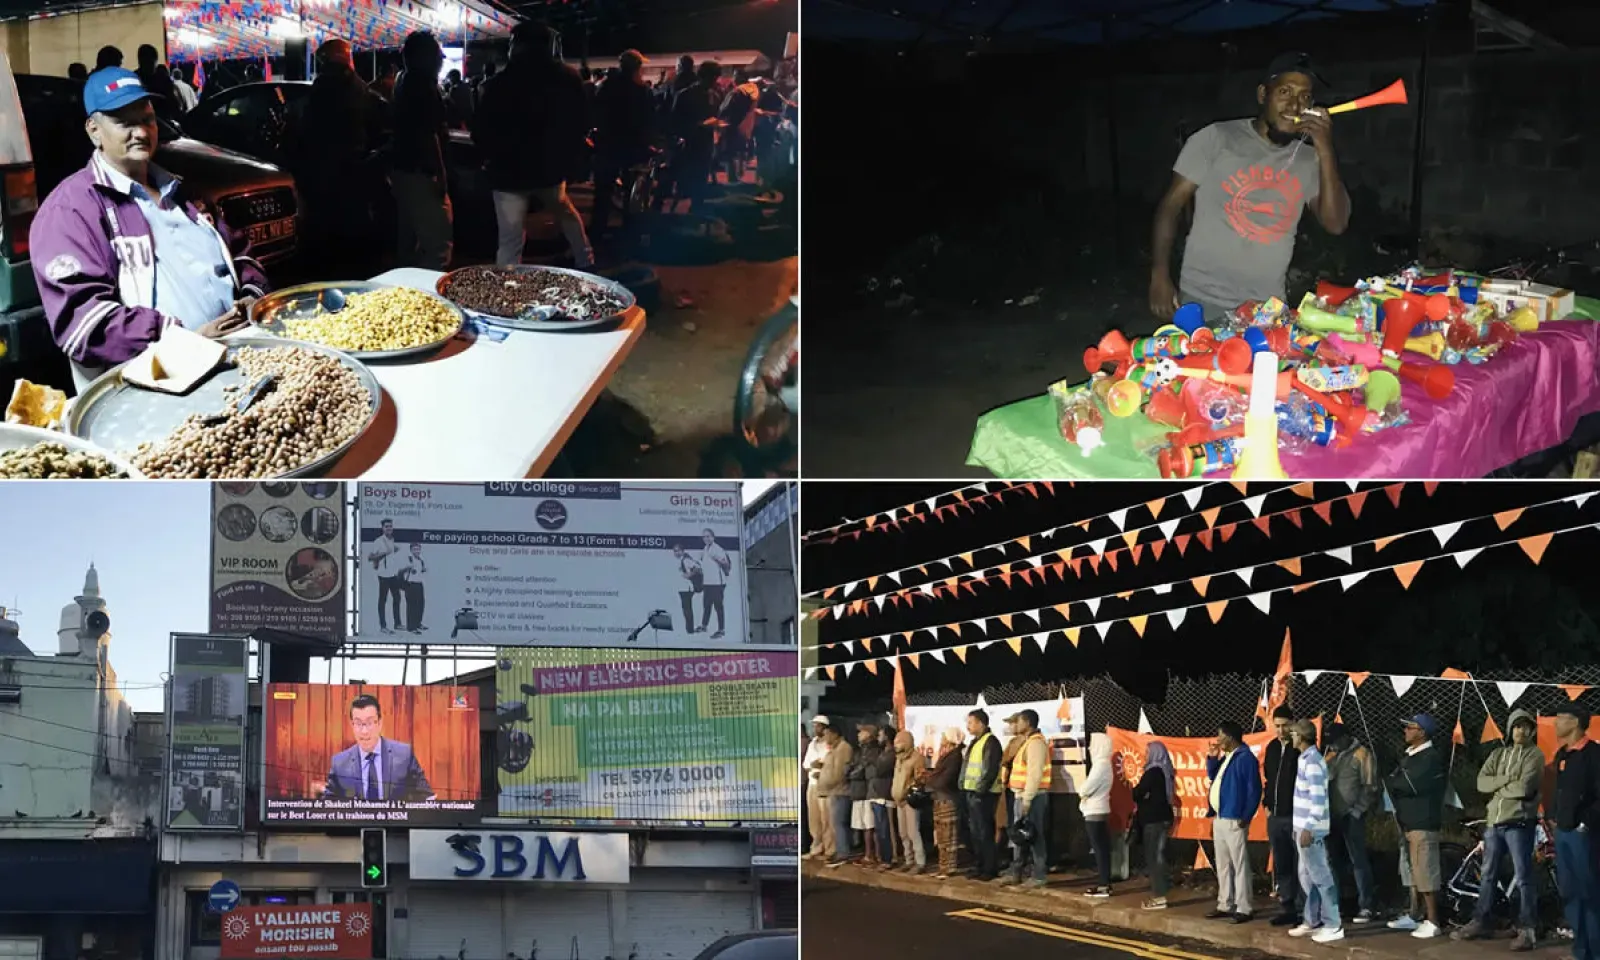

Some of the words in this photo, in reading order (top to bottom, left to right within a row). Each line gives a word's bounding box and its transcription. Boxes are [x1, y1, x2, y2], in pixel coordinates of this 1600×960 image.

[364, 486, 397, 499] Boys
[402, 488, 432, 500] Dept
[489, 481, 517, 494] City
[522, 481, 575, 495] College
[670, 496, 700, 506] Girls
[704, 496, 734, 508] Dept
[422, 532, 441, 541] Fee
[444, 533, 479, 543] paying
[481, 534, 515, 542] school
[518, 534, 548, 543] Grade
[551, 535, 556, 543] 7
[574, 536, 586, 544] 13
[586, 536, 616, 546] (Form
[628, 537, 637, 546] to
[640, 537, 666, 548] HSC)
[469, 546, 490, 555] Boys
[557, 550, 592, 558] separate
[220, 558, 239, 568] VIP
[242, 558, 278, 568] ROOM
[482, 587, 502, 596] highly
[226, 604, 259, 612] Booking
[474, 599, 519, 608] Experienced
[540, 671, 583, 689] NEW
[588, 663, 678, 686] ELECTRIC
[682, 658, 772, 678] SCOOTER
[563, 702, 590, 718] NA
[599, 701, 624, 716] PA
[600, 773, 627, 786] TEL
[631, 768, 674, 784] 5976
[678, 766, 726, 782] 0000
[732, 784, 757, 792] LOUIS
[268, 800, 312, 808] Intervention
[314, 800, 322, 808] de
[325, 800, 352, 808] Shakeel
[354, 800, 389, 808] Mohamed
[442, 801, 475, 809] nationale
[281, 811, 287, 819] le
[289, 811, 304, 819] Best
[306, 811, 326, 819] Loser
[337, 811, 344, 819] la
[345, 811, 374, 820] trahison
[376, 812, 386, 820] du
[387, 812, 408, 820] MSM
[450, 835, 586, 879] SBM
[254, 911, 341, 925] L'ALLIANCE
[260, 928, 334, 942] MORISIEN
